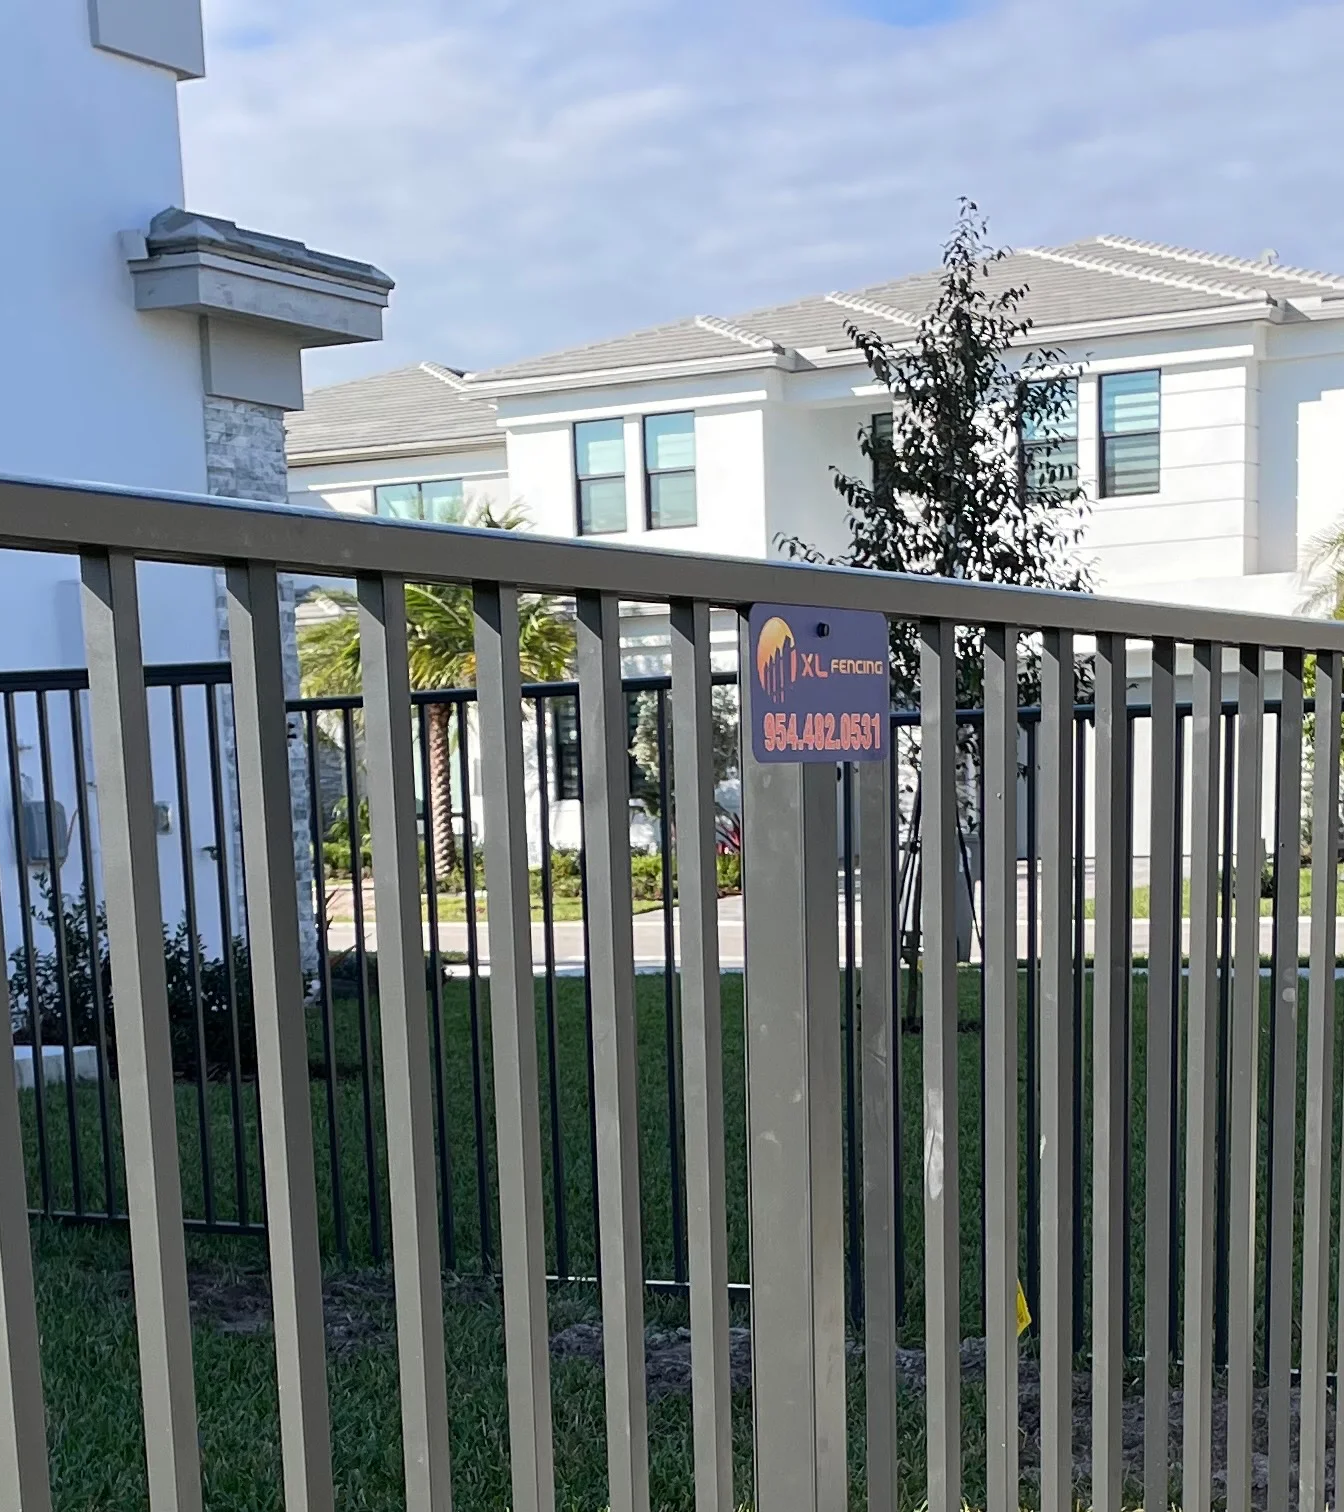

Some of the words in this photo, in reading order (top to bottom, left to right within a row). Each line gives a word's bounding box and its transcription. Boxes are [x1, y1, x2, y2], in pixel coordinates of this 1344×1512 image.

[801, 653, 828, 678] XL
[830, 658, 883, 675] FENCING
[764, 712, 881, 752] 954.482.0531
